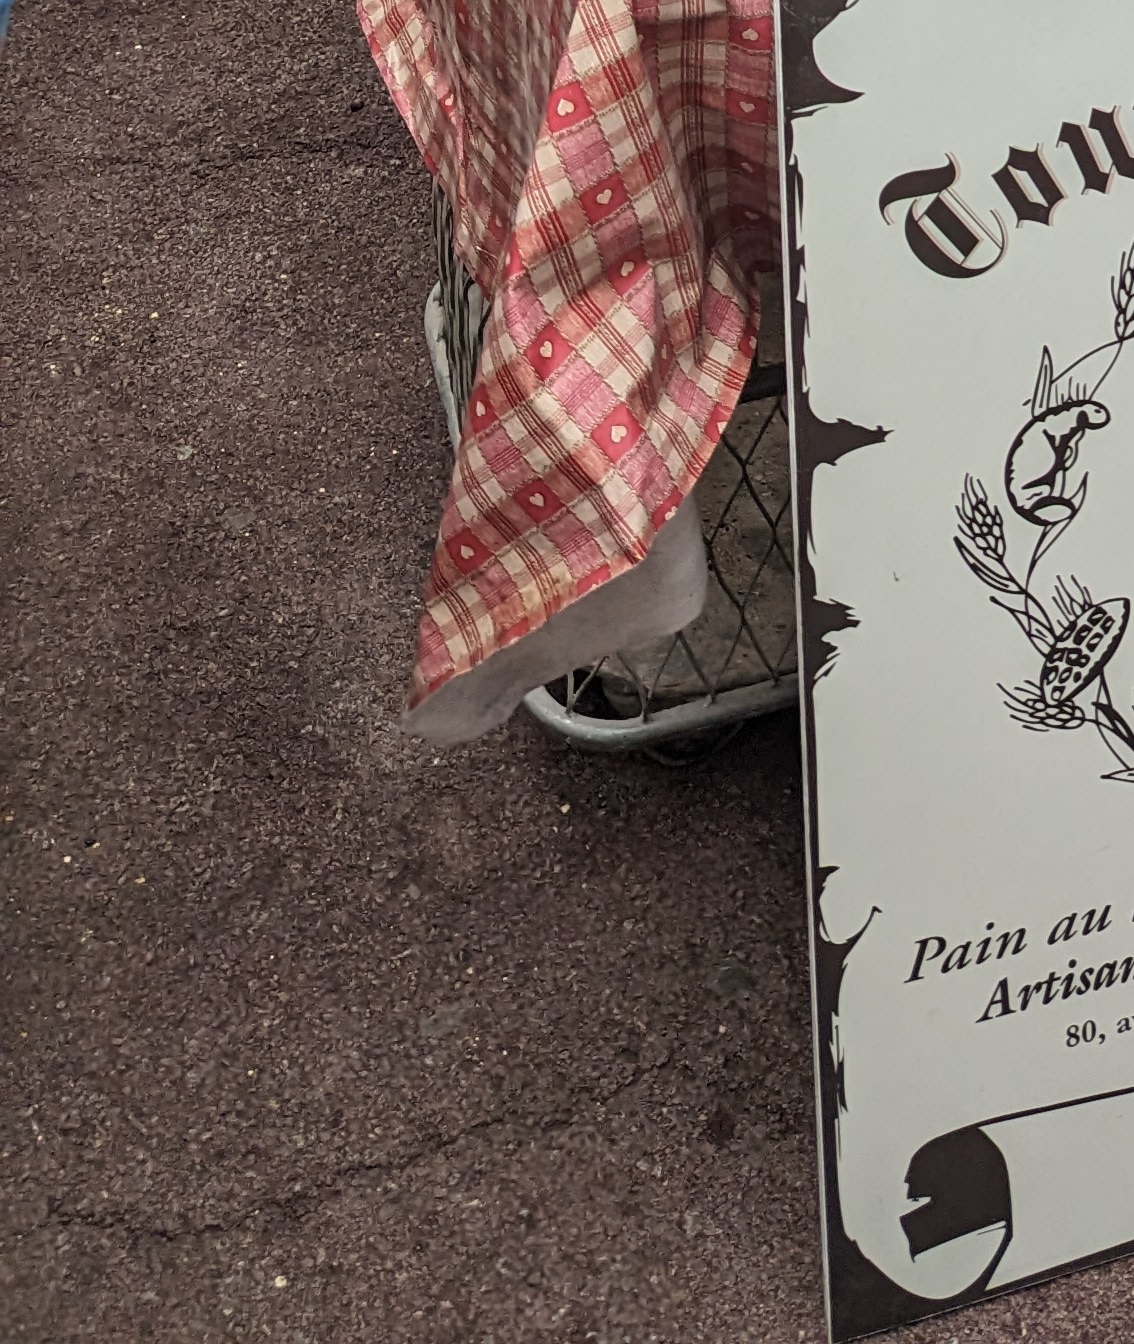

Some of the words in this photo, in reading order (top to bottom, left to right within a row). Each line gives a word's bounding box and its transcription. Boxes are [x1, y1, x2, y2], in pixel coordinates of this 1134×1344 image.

[904, 921, 1027, 984] Pain
[1047, 904, 1112, 946] au
[1066, 1019, 1106, 1048] 80,
